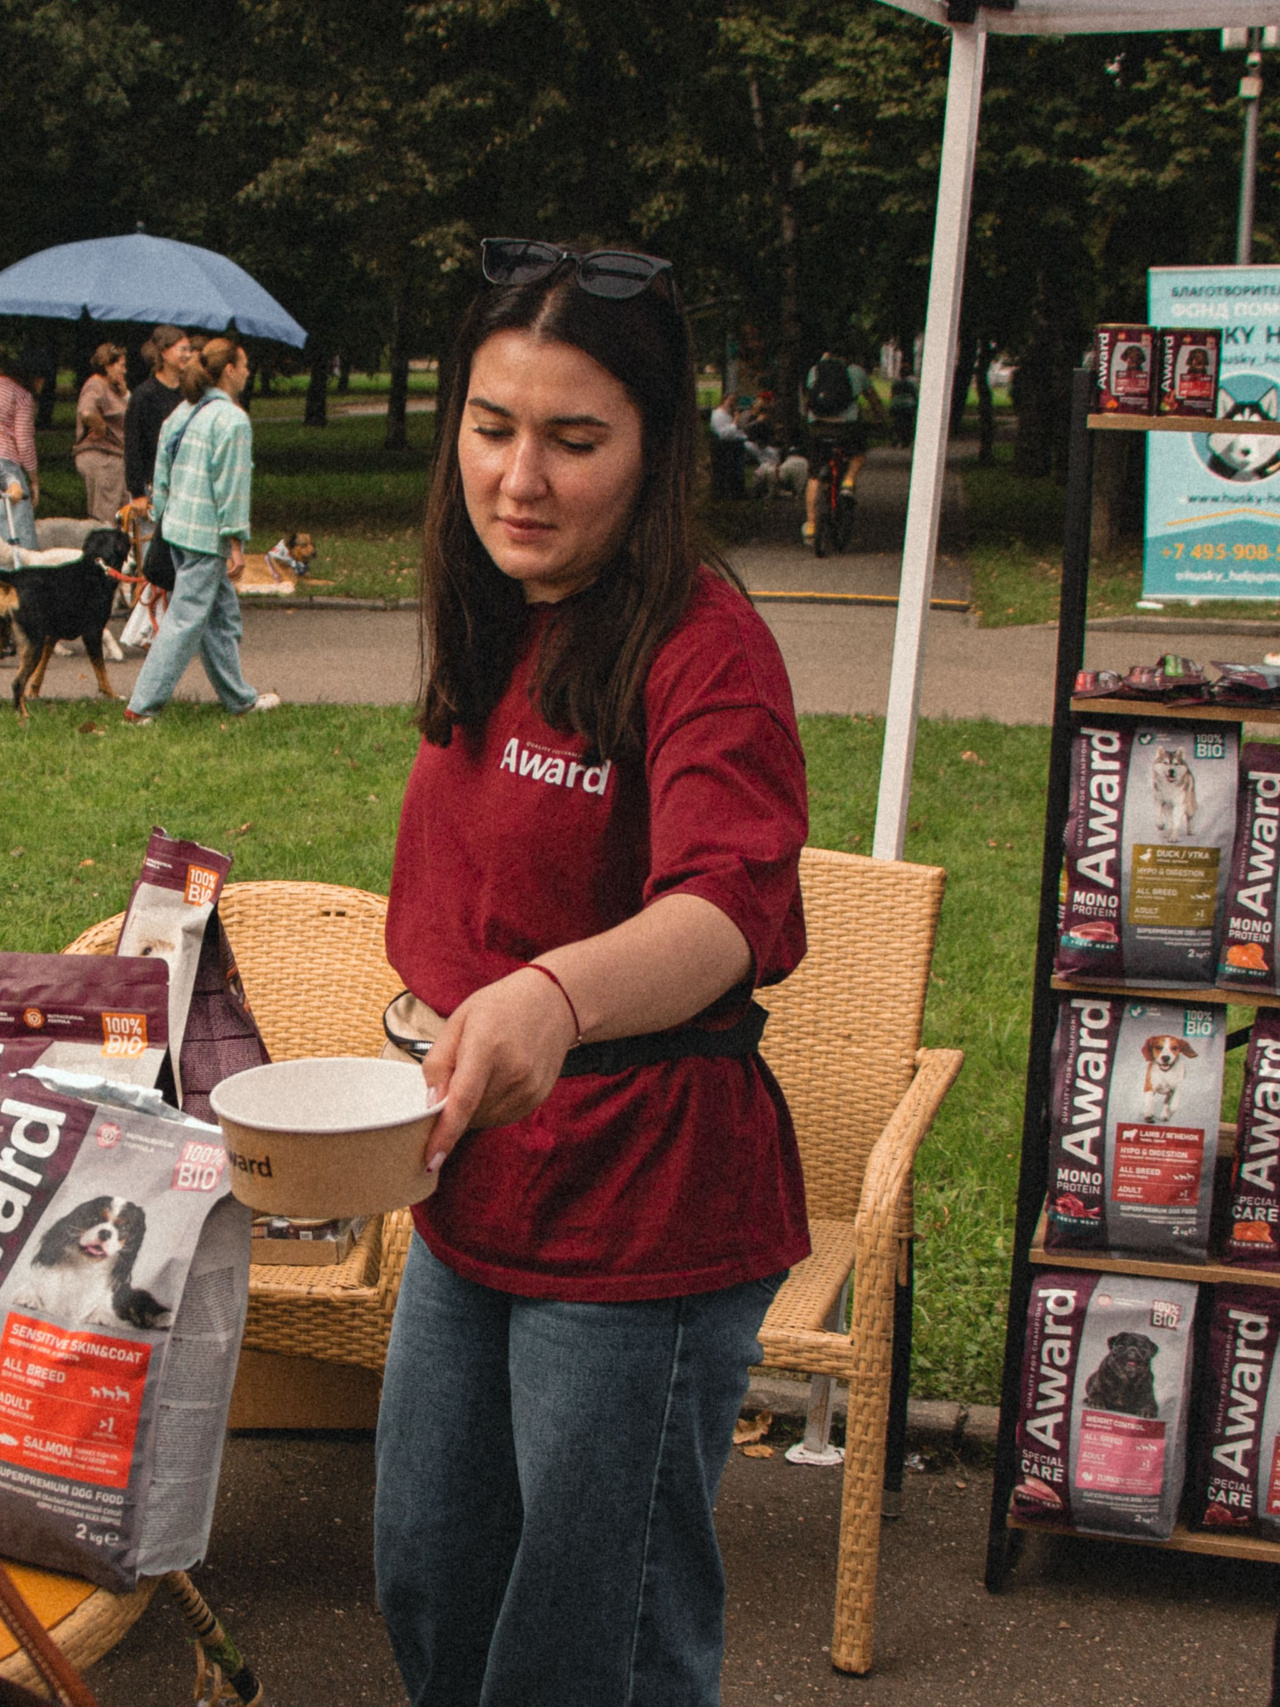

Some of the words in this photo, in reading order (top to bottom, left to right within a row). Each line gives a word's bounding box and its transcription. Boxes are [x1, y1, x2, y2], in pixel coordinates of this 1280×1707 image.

[1171, 301, 1229, 319] ФОНД
[1097, 332, 1110, 390] Award
[1161, 335, 1174, 393] Award
[1161, 543, 1185, 560] +7
[1196, 733, 1223, 744] 100%
[1196, 743, 1223, 758] BIO
[500, 737, 611, 796] Award
[1076, 727, 1121, 888] Award
[1076, 810, 1084, 848] QUALITY
[1156, 849, 1180, 858] DUCK
[1237, 771, 1280, 917] Award
[190, 868, 216, 890] 100%
[1073, 890, 1118, 909] MONO
[1072, 904, 1117, 919] PROTEIN
[1229, 917, 1272, 934] MONO
[1228, 930, 1270, 944] PROTEIN
[1187, 948, 1196, 958] 2
[105, 1016, 142, 1035] 100%
[1186, 1010, 1213, 1022] 100%
[1186, 1021, 1213, 1035] BIO
[106, 1034, 143, 1055] BIO
[1061, 999, 1111, 1166] Award
[1061, 1087, 1070, 1124] QUALITY
[1139, 1130, 1160, 1139] LAMB
[185, 1144, 227, 1166] 100%
[227, 1149, 274, 1178] ward
[177, 1163, 218, 1191] BIO
[1057, 1168, 1102, 1185] MONO
[1119, 1166, 1135, 1174] ALL
[1135, 1167, 1162, 1176] BREED
[1056, 1180, 1100, 1195] PROTEIN
[1117, 1185, 1142, 1194] ADULT
[1232, 1205, 1280, 1222] CARE
[1172, 1225, 1180, 1236] 2
[1153, 1301, 1180, 1315] 100%
[1152, 1311, 1178, 1328] BIO
[10, 1323, 70, 1350] SENSITIVE
[70, 1340, 143, 1364] SKIN&COAT
[3, 1356, 23, 1373] ALL
[26, 1364, 66, 1384] BREED
[1026, 1288, 1078, 1450] Award
[1029, 1357, 1038, 1375] FOR
[1026, 1375, 1035, 1409] QUALITY
[1213, 1308, 1269, 1478] Award
[1085, 1415, 1114, 1426] WEIGHT
[1113, 1420, 1146, 1432] CONTROL
[22, 1434, 73, 1458] SALMON
[1022, 1449, 1064, 1468] SPECIAL
[1020, 1459, 1064, 1483] CARE
[71, 1486, 93, 1500] DOG
[95, 1491, 125, 1505] FOOD
[1207, 1486, 1253, 1509] CARE
[75, 1523, 88, 1539] 2
[89, 1532, 104, 1546] kg
